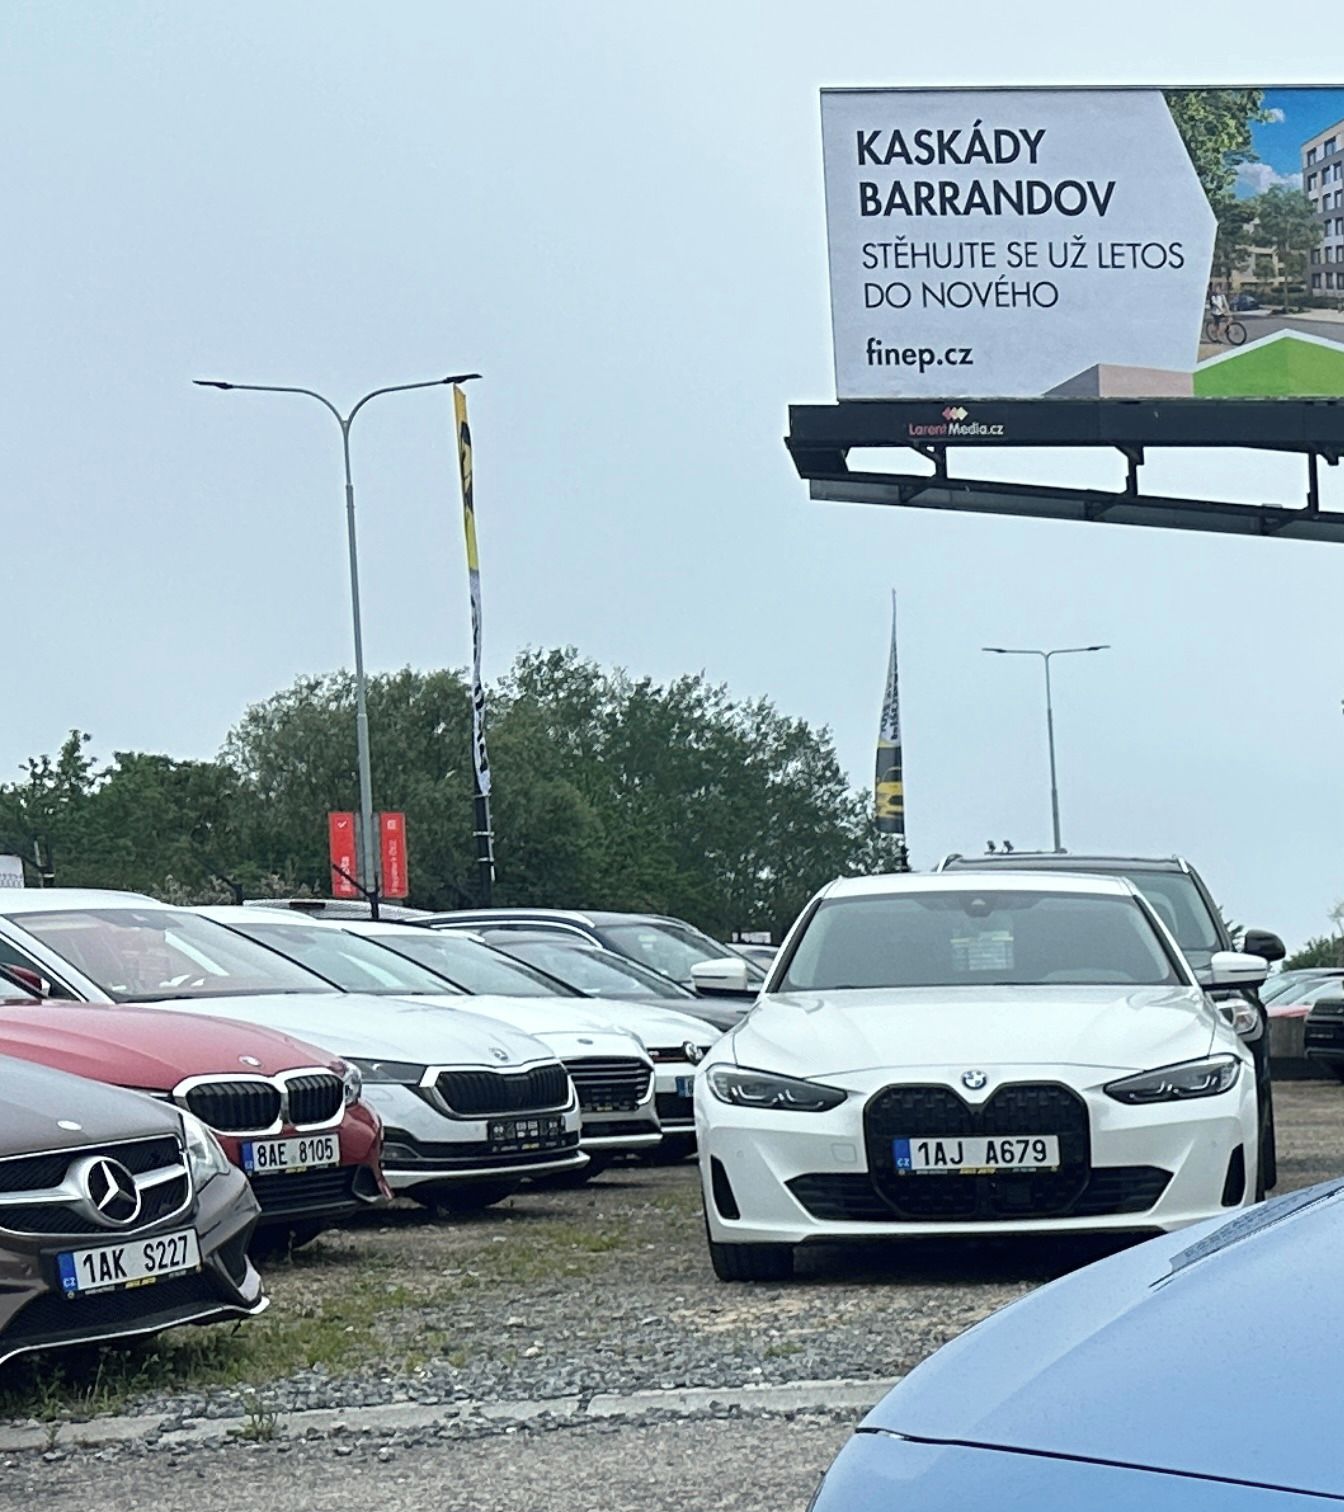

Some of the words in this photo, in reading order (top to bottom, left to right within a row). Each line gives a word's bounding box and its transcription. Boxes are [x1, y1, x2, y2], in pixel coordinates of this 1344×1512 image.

[856, 119, 1046, 165] KASKÁDY
[859, 179, 1116, 217] BARRANDOV
[862, 235, 996, 269] STĚHUJTE
[1007, 241, 1039, 268] SE
[1048, 235, 1088, 268] UŽ
[1098, 242, 1184, 269] LETOS
[864, 282, 911, 308] DO
[922, 274, 1059, 308] NOVÉHO
[866, 337, 973, 373] finep.cz
[257, 1143, 287, 1167] 8AE
[299, 1138, 333, 1163] 8105
[918, 1141, 963, 1166] 1AJ
[986, 1139, 1047, 1164] A679
[83, 1248, 127, 1283] 1AK
[143, 1235, 188, 1272] S227
[63, 1277, 77, 1288] CZ
